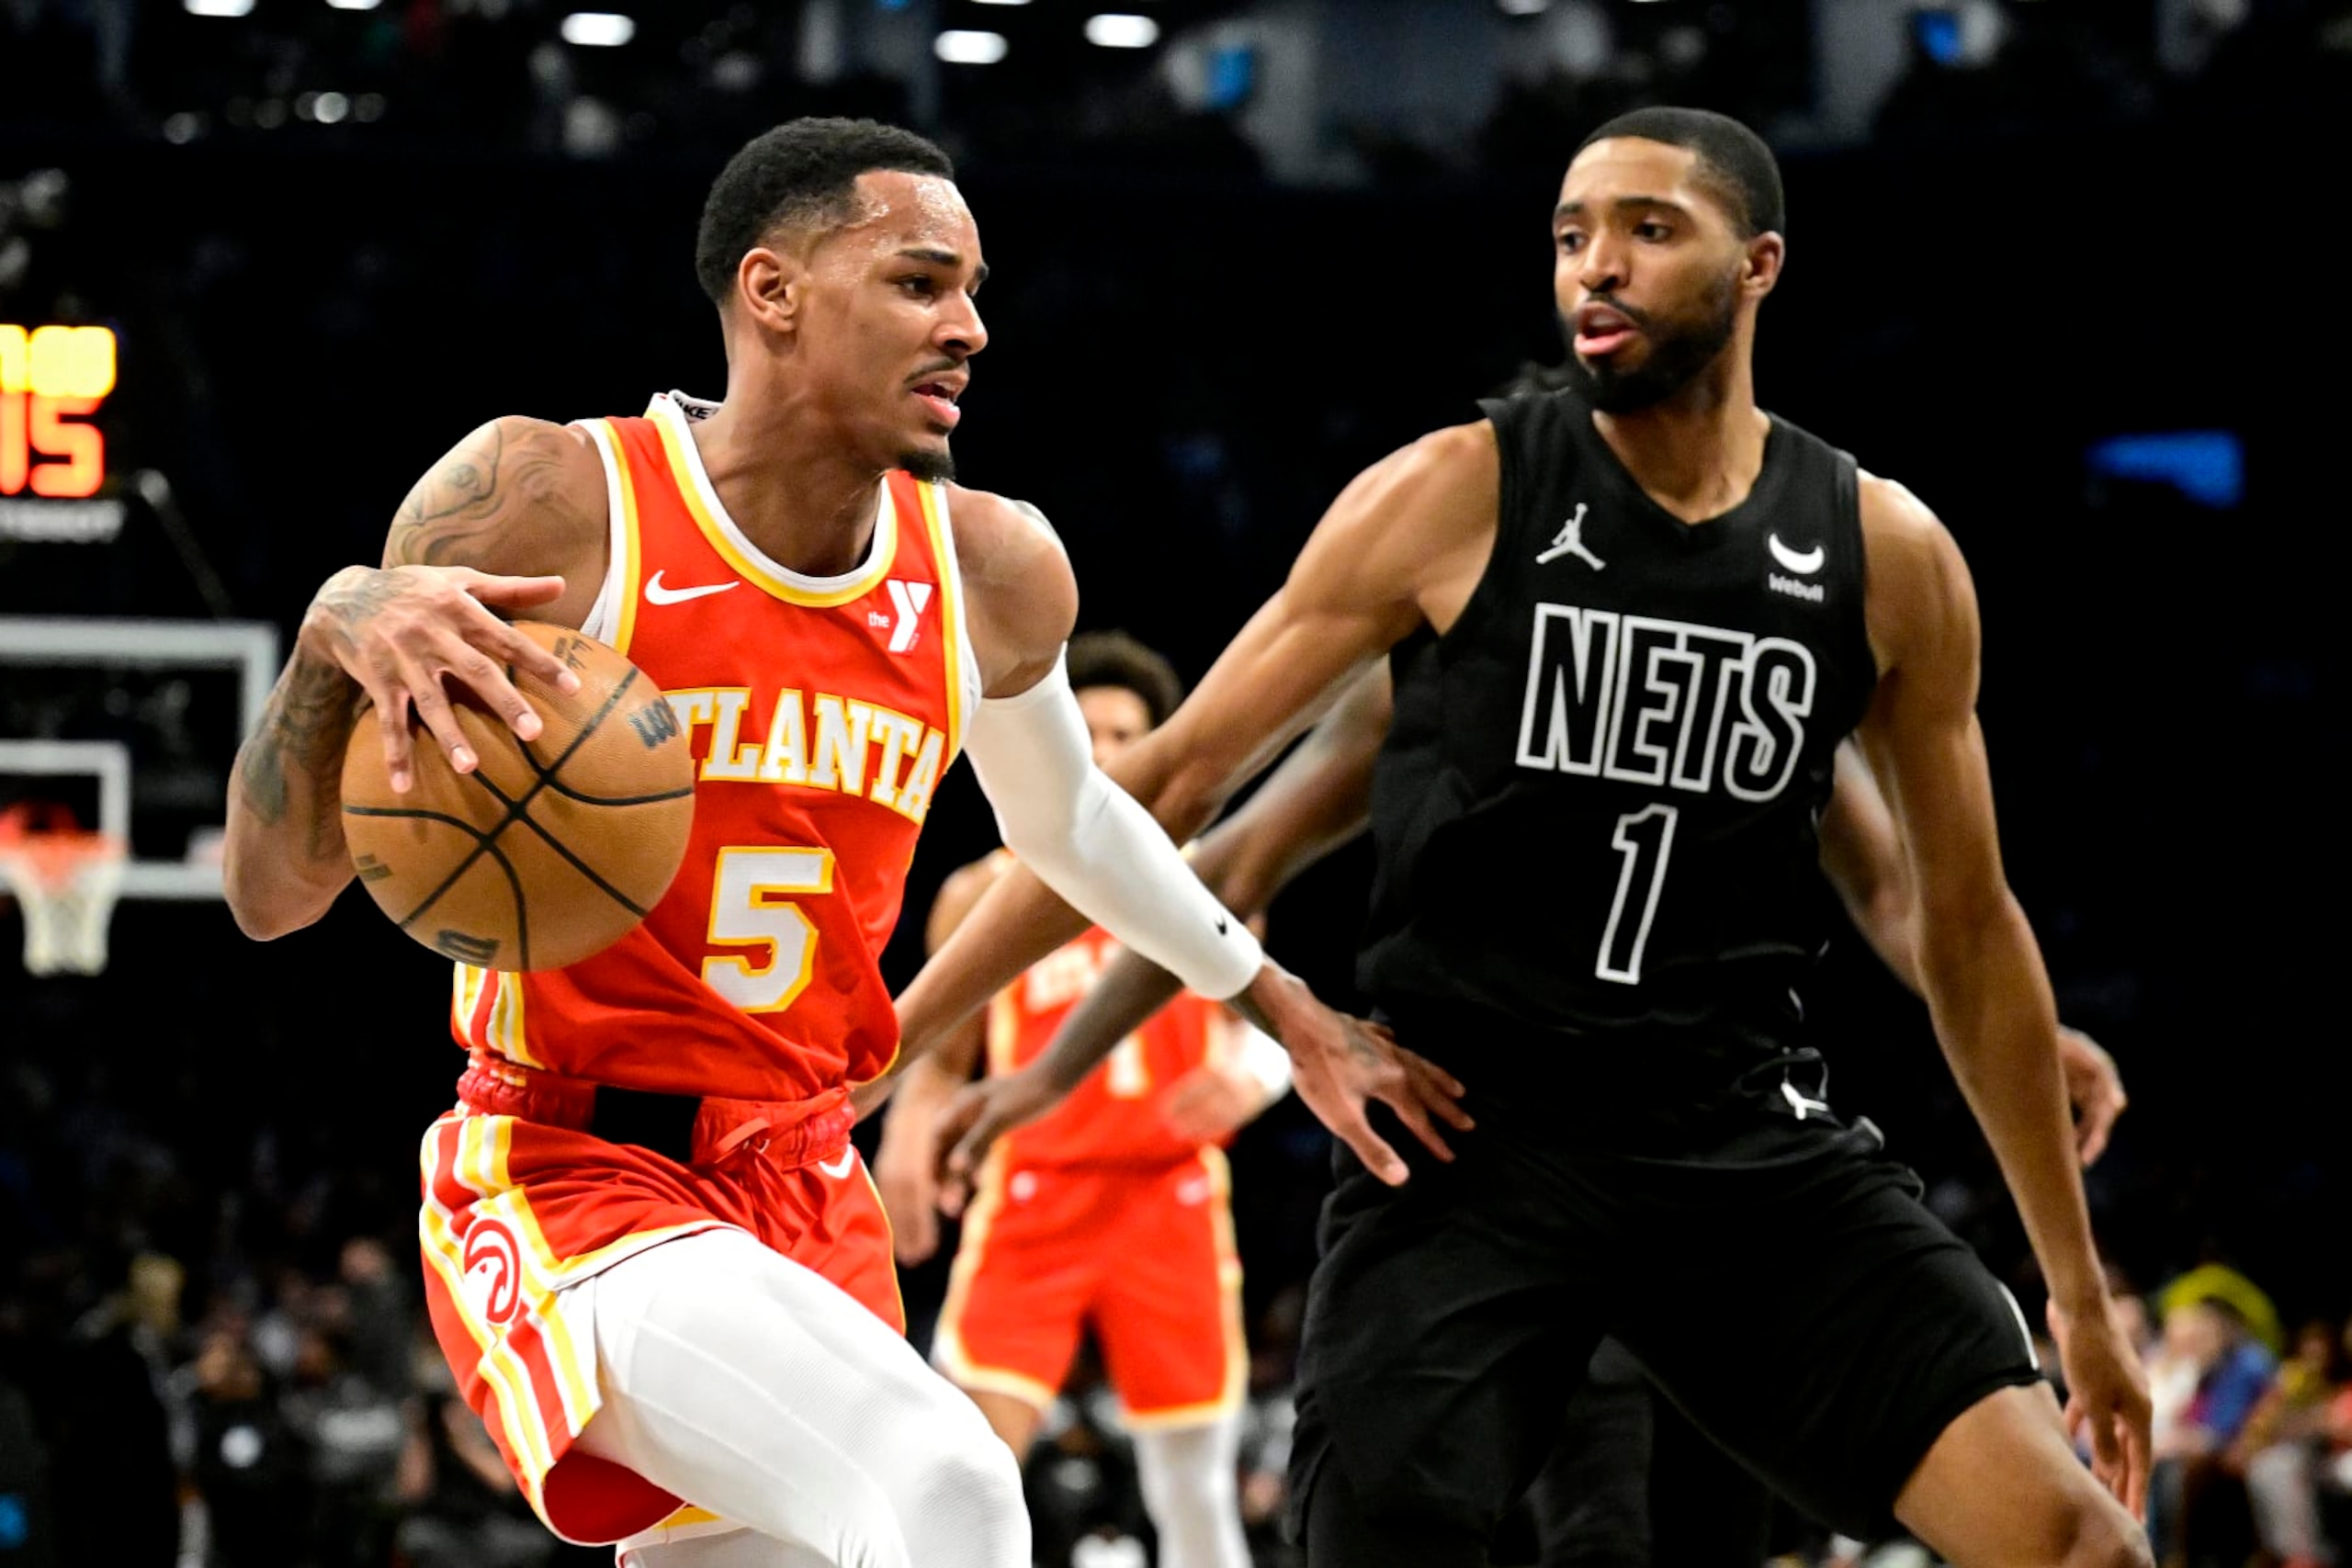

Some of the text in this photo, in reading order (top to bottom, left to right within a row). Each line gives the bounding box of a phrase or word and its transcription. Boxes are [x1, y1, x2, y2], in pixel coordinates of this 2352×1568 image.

[867, 611, 890, 628] the
[886, 579, 933, 652] Y
[1769, 572, 1825, 604] Webull
[662, 686, 946, 826] TLANTA
[1515, 602, 1816, 803] NETS
[701, 845, 836, 1013] 5
[1595, 803, 1678, 985] 1
